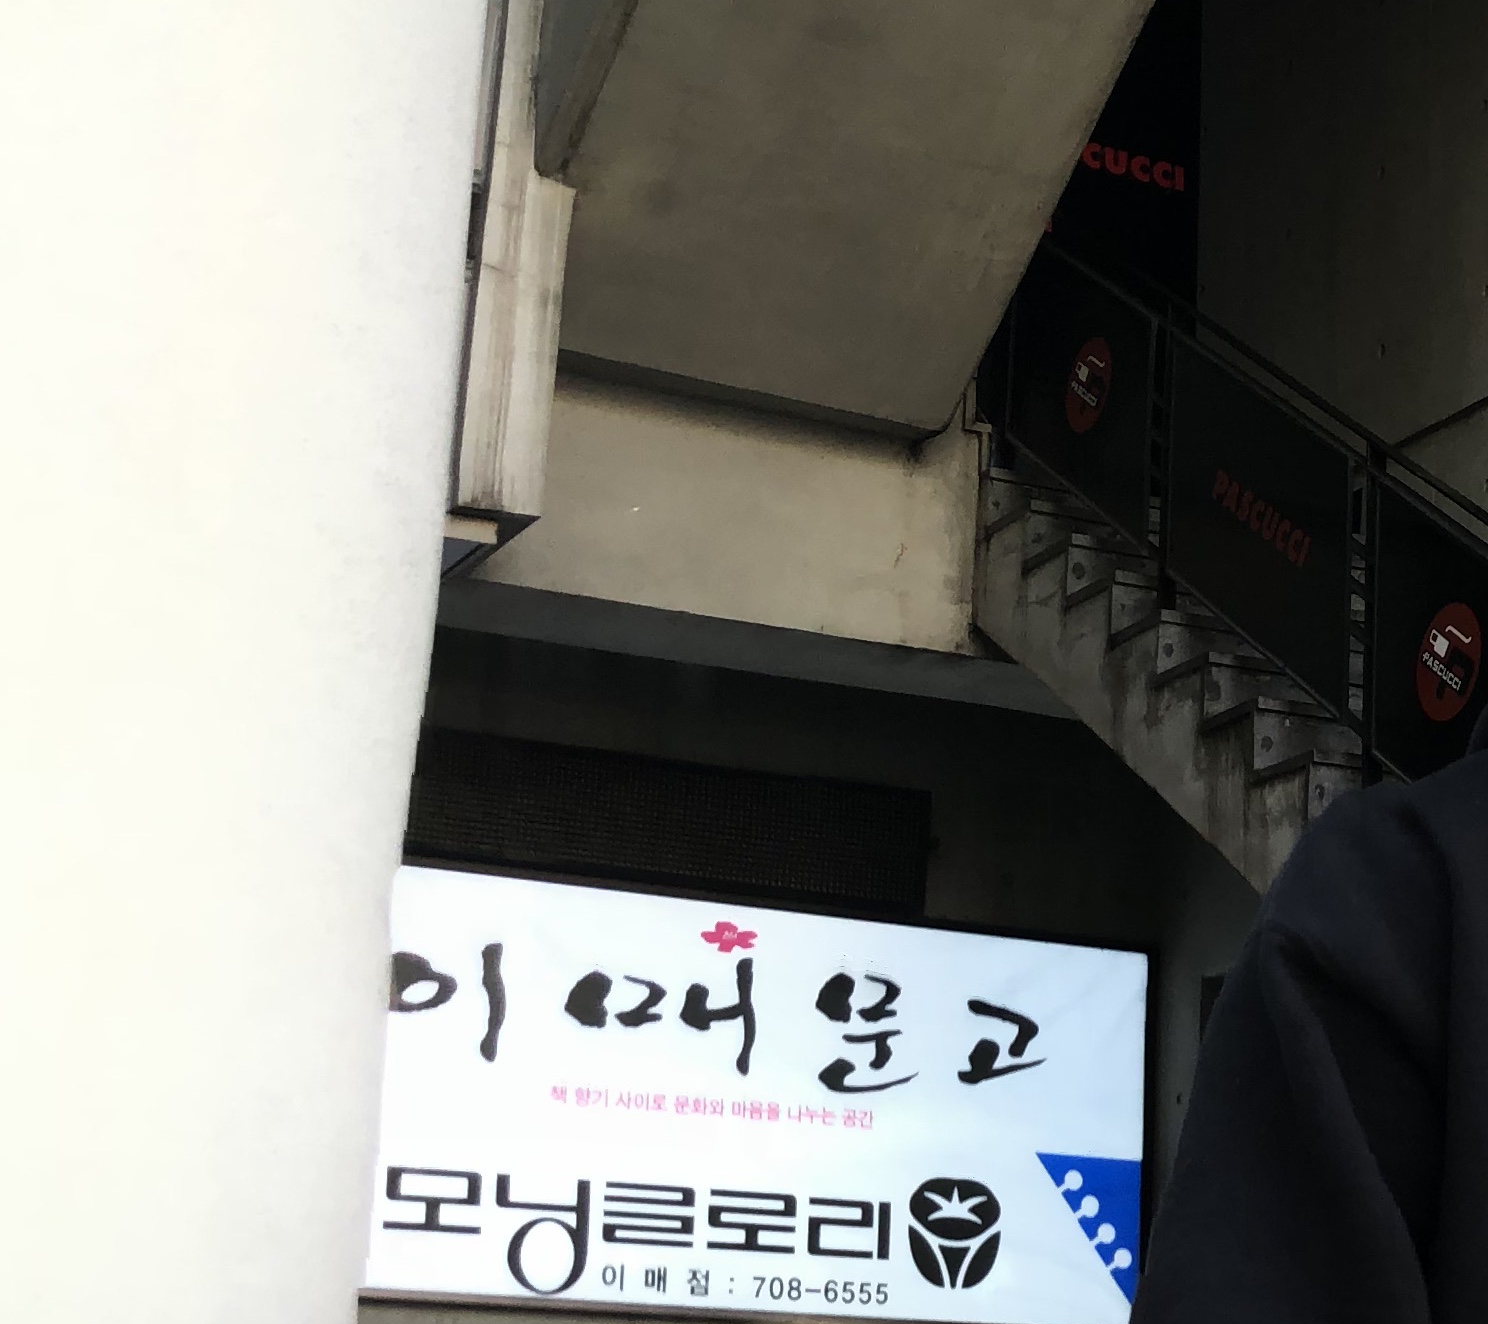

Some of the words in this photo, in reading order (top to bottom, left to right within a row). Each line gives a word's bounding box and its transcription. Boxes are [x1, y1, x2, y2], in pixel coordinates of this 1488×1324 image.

[1082, 143, 1185, 192] CUCCI
[1212, 468, 1313, 567] PASCUCCI
[615, 1091, 668, 1112] 사이로
[673, 1094, 725, 1118] 문화와
[787, 1103, 836, 1127] 나누는
[842, 1107, 874, 1131] 공간
[383, 1164, 892, 1295] 모닝글로리
[752, 1275, 889, 1305] 708-6555
